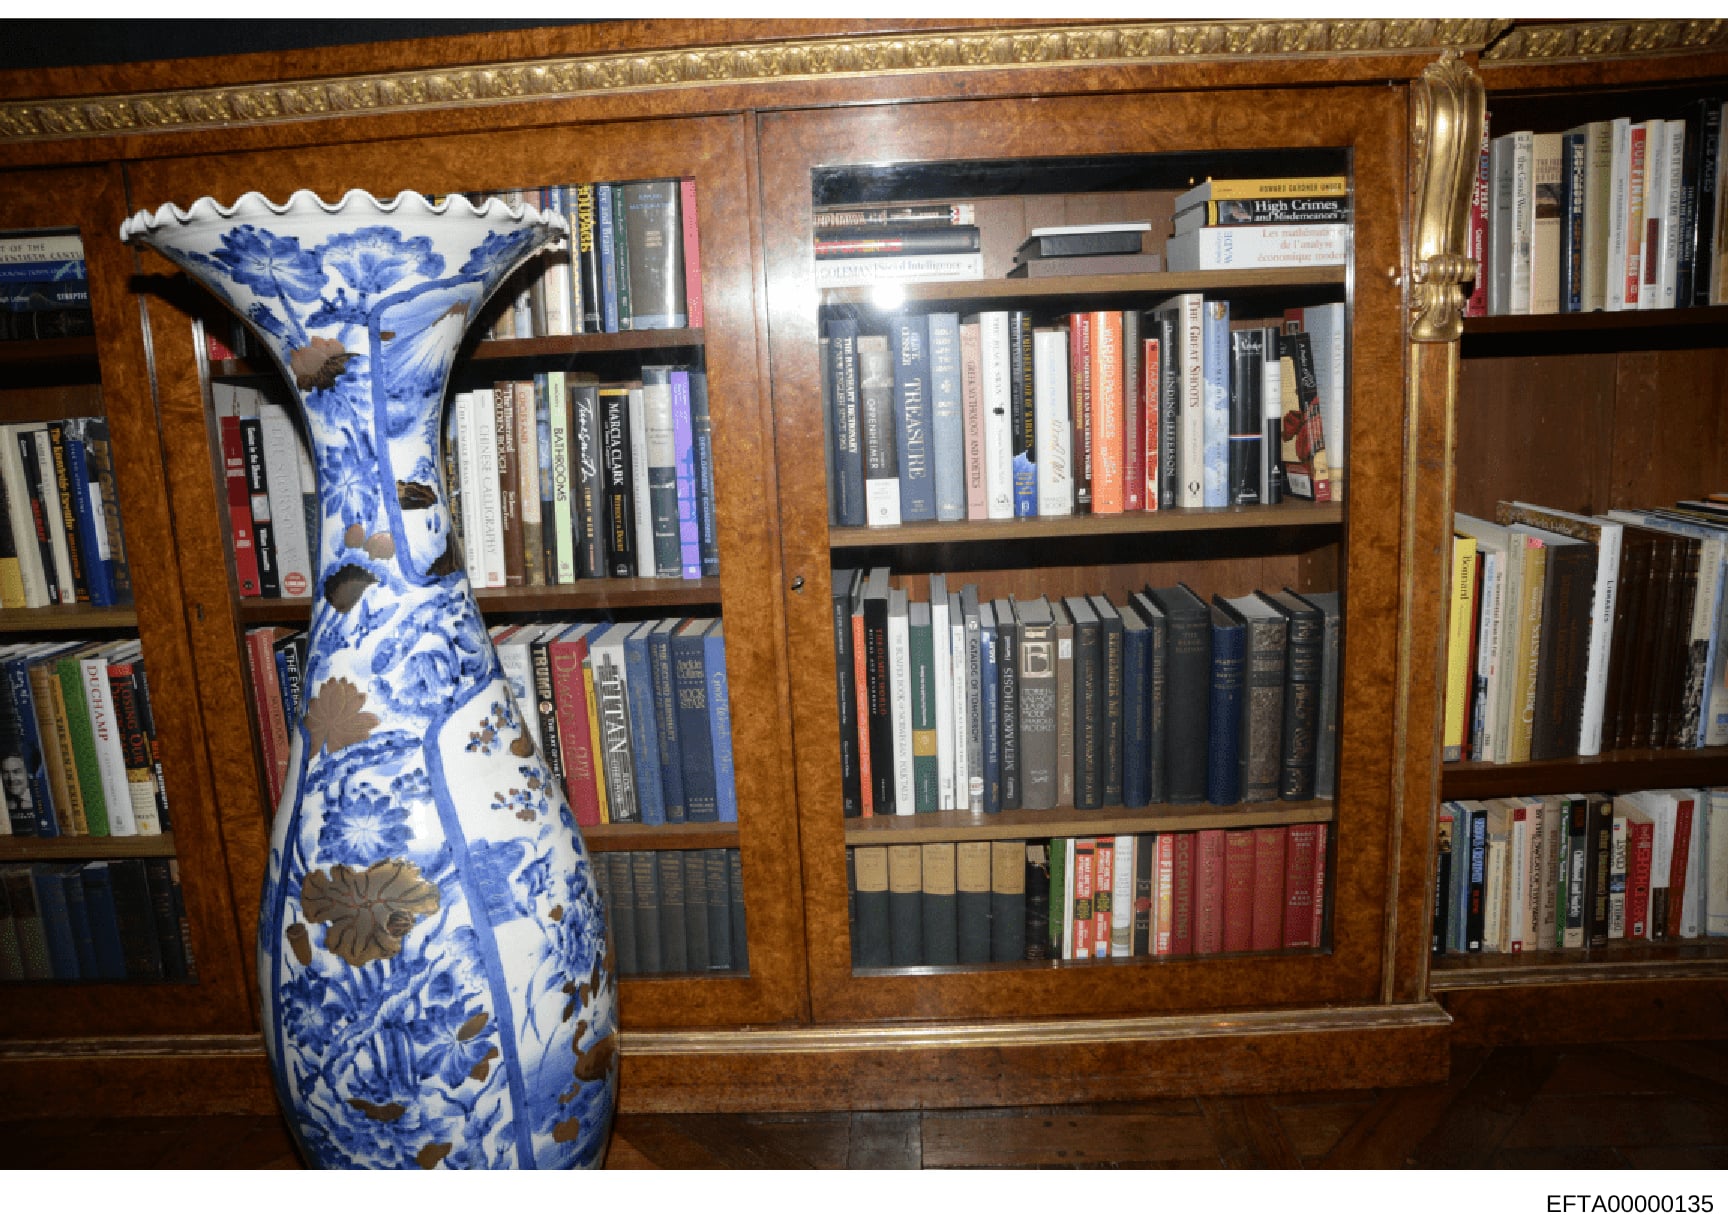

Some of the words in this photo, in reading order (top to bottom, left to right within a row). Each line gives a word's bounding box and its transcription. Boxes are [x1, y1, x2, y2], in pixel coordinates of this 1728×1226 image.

[1632, 141, 1643, 168] OUR
[1705, 134, 1717, 157] ICE
[1480, 156, 1488, 181] DID
[1704, 159, 1716, 193] AGES
[599, 185, 611, 203] Eye
[1289, 183, 1317, 192] GARDNER
[1480, 182, 1489, 220] THEY
[1631, 169, 1643, 213] FINAL
[602, 206, 612, 224] and
[1254, 199, 1288, 215] High
[1291, 198, 1338, 211] Crimes
[1254, 214, 1271, 222] and
[1274, 212, 1338, 221] Misdemeanors
[603, 227, 613, 255] Brain
[1223, 231, 1233, 264] WADE
[1262, 229, 1279, 238] Les
[1282, 240, 1291, 249] de
[907, 257, 960, 273] Intelligence
[1257, 251, 1312, 263] économique
[992, 317, 1001, 339] THE
[1189, 298, 1201, 321] THE
[843, 337, 853, 357] THE
[901, 326, 913, 366] CUSSLER
[1082, 320, 1090, 353] PROTECT
[1102, 328, 1116, 378] WARPED
[1189, 325, 1201, 361] GREAT
[966, 361, 978, 386] GREEK
[993, 343, 1002, 369] BLACK
[994, 373, 1003, 396] SWAN
[1166, 370, 1177, 418] FINDING
[1189, 365, 1202, 408] SHOOTS
[1215, 368, 1223, 412] MACHINE
[494, 388, 505, 431] GOLDEN
[608, 403, 622, 446] MARCIA
[968, 387, 980, 436] MYTHOLOGY
[1104, 379, 1117, 439] PASSAGES
[846, 403, 858, 454] DICTIONARY
[867, 398, 881, 470] OPPENHEIMER
[902, 377, 928, 481] TREASURE
[479, 425, 494, 473] CHINESE
[553, 427, 567, 502] BATHROOMS
[970, 440, 981, 457] AND
[1166, 420, 1177, 477] JEFFERSON
[611, 449, 624, 486] CLARK
[971, 458, 983, 489] POETICS
[481, 476, 499, 555] CALLIGRAPHY
[1460, 554, 1473, 601] Bonnard
[1603, 580, 1615, 623] LIBRARIES
[286, 655, 296, 673] THE
[533, 646, 552, 700] TRUMP
[969, 638, 980, 676] CATALOG
[1522, 625, 1542, 724] ORIENTALISTES
[555, 650, 577, 726] DRAGON
[878, 682, 887, 716] WORLD
[896, 680, 905, 701] BOOK
[970, 679, 980, 690] OF
[87, 665, 108, 742] DUCHAMP
[122, 681, 138, 730] LOSING
[601, 674, 628, 753] TITAN
[970, 691, 980, 744] TOMORROW
[1003, 667, 1015, 771] METAMORPHOSIS
[1162, 836, 1172, 859] OUR
[1614, 839, 1626, 870] COAST
[1159, 860, 1172, 898] FINAL
[1176, 834, 1189, 940] LOCKSMITHING
